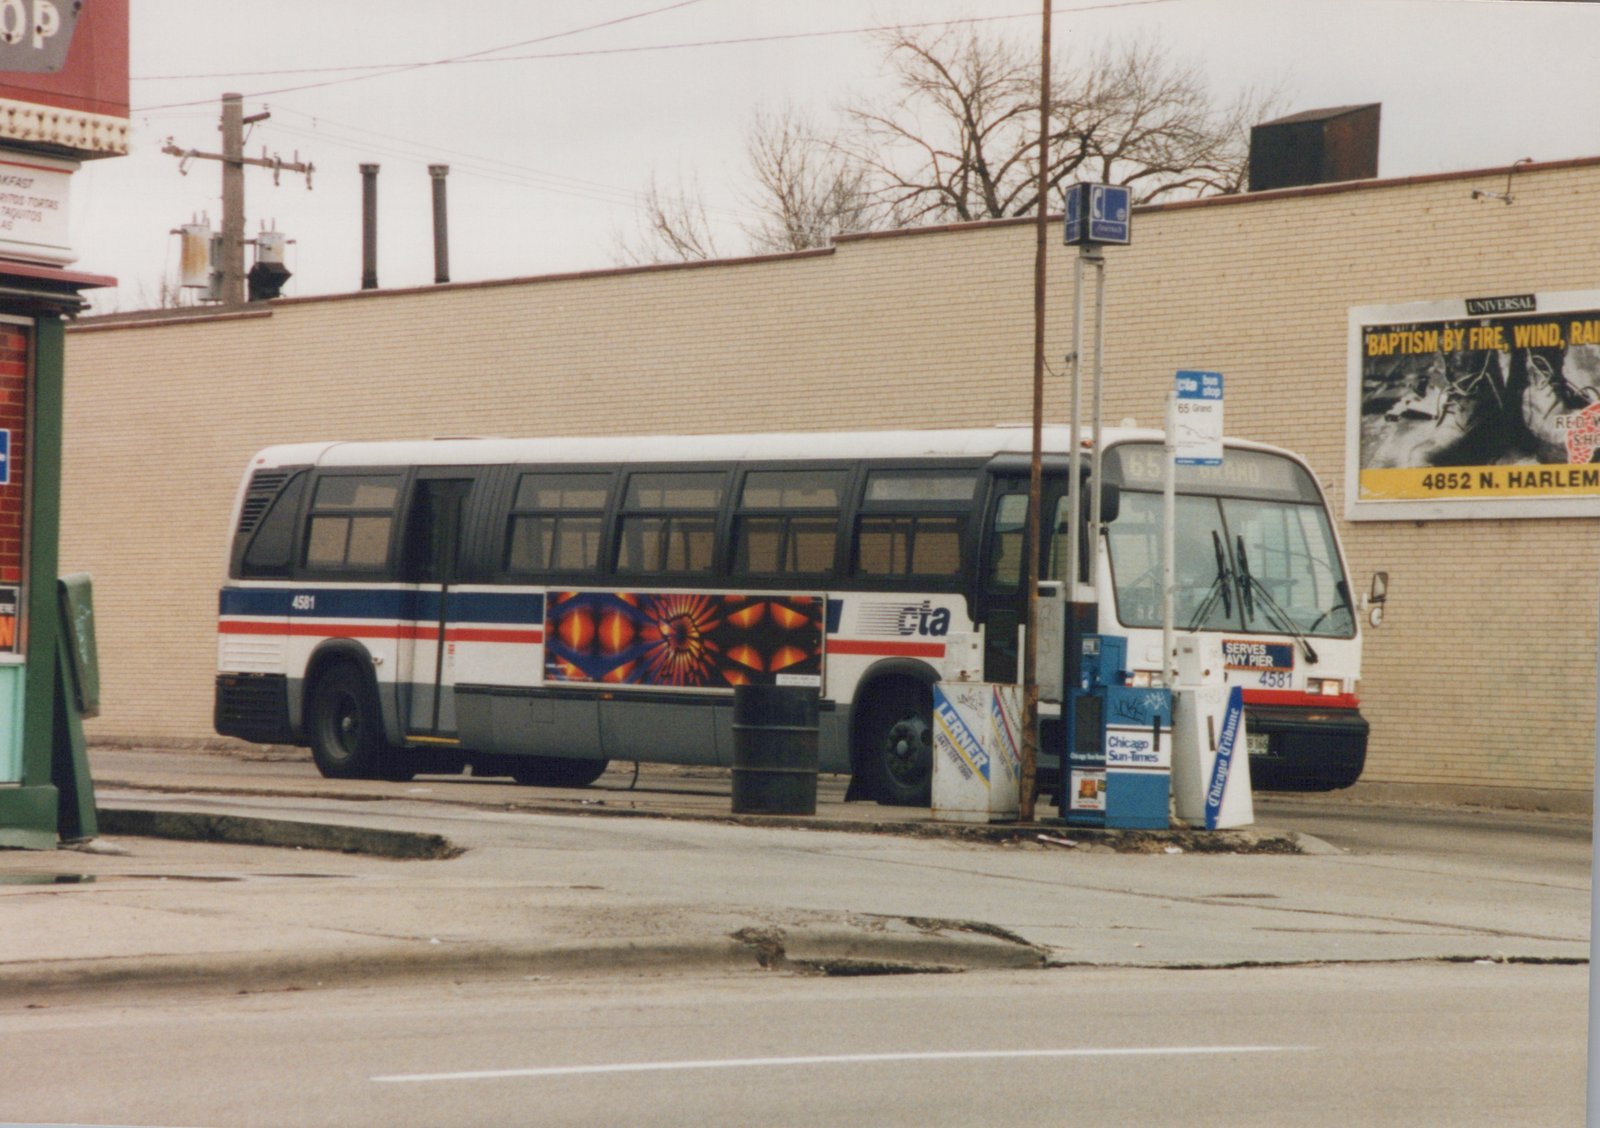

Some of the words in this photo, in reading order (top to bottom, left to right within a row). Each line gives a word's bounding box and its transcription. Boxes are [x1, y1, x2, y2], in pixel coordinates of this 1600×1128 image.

[1469, 297, 1534, 313] UNIVERSAL
[1367, 330, 1439, 356] BAPTISM
[1443, 328, 1464, 352] BY
[1469, 326, 1509, 352] FIRE,
[1514, 322, 1566, 349] WIND,
[1178, 403, 1190, 414] 65
[1192, 403, 1213, 413] Grand
[1556, 416, 1585, 429] RED
[1128, 451, 1161, 479] 65
[1422, 473, 1472, 490] 4852
[1479, 472, 1499, 488] N.
[1508, 470, 1600, 489] HARLEM
[292, 595, 316, 610] 4581
[898, 600, 951, 637] cta
[1225, 642, 1267, 655] SERVES
[1222, 653, 1247, 665] AVY
[1249, 654, 1274, 667] PIER
[1258, 671, 1293, 688] 4581
[936, 701, 988, 768] LERNER
[1108, 735, 1149, 751] Chicago
[1108, 750, 1159, 763] Sun-Times
[1207, 758, 1227, 807] Chicago
[1218, 707, 1240, 757] Tribune
